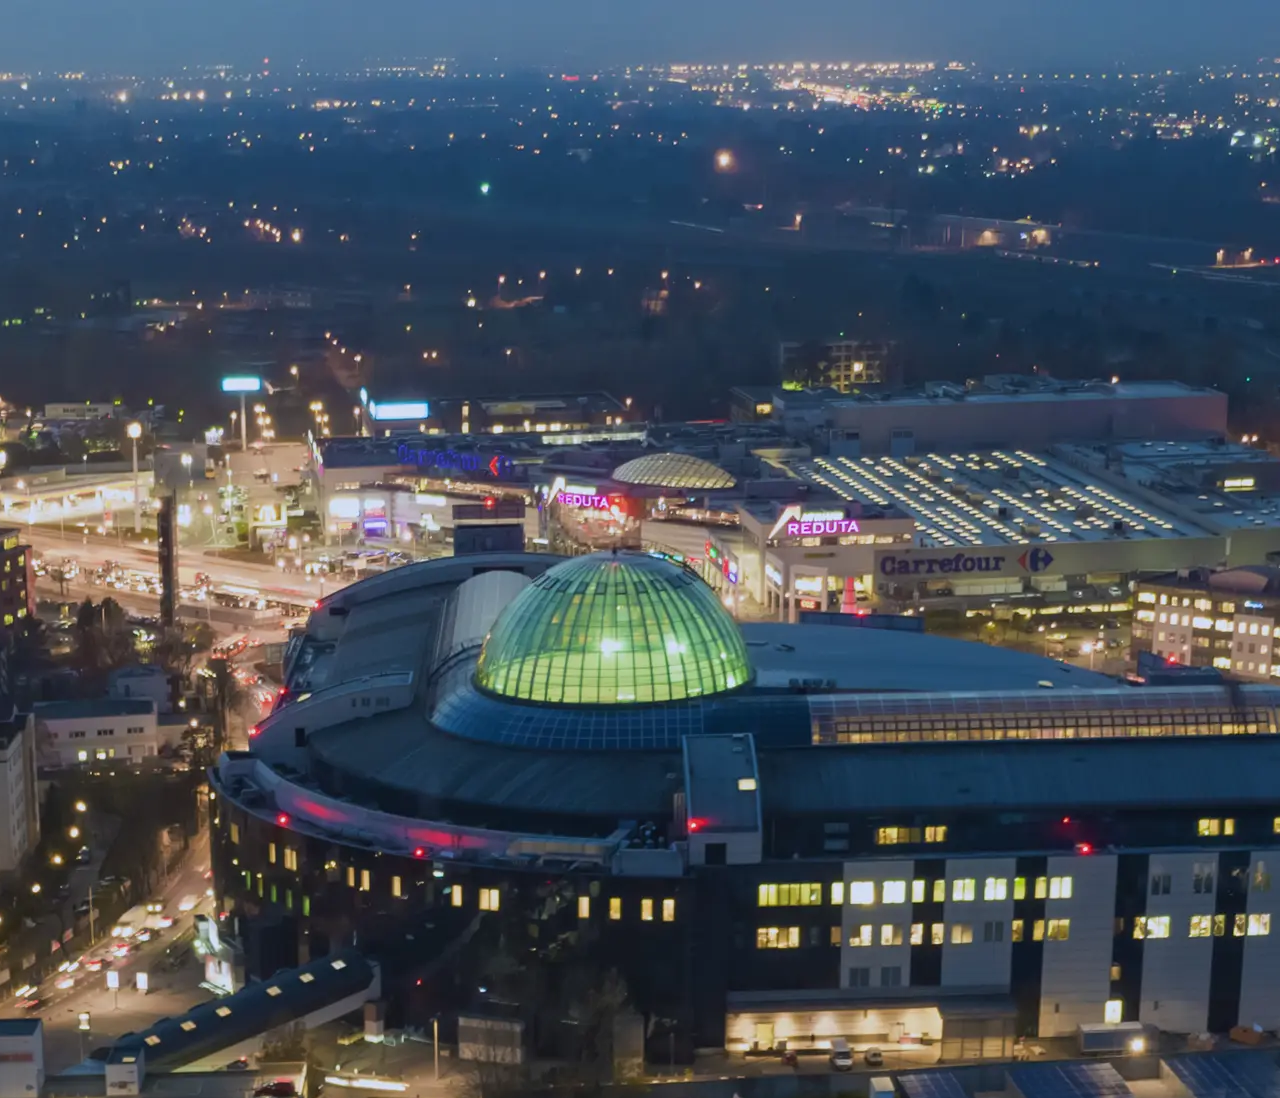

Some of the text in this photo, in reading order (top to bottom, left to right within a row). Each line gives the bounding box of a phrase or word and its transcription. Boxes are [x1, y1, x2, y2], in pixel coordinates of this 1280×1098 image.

[558, 493, 609, 508] REDUTA
[787, 519, 859, 535] REDUTA
[880, 554, 1005, 576] Carrefour
